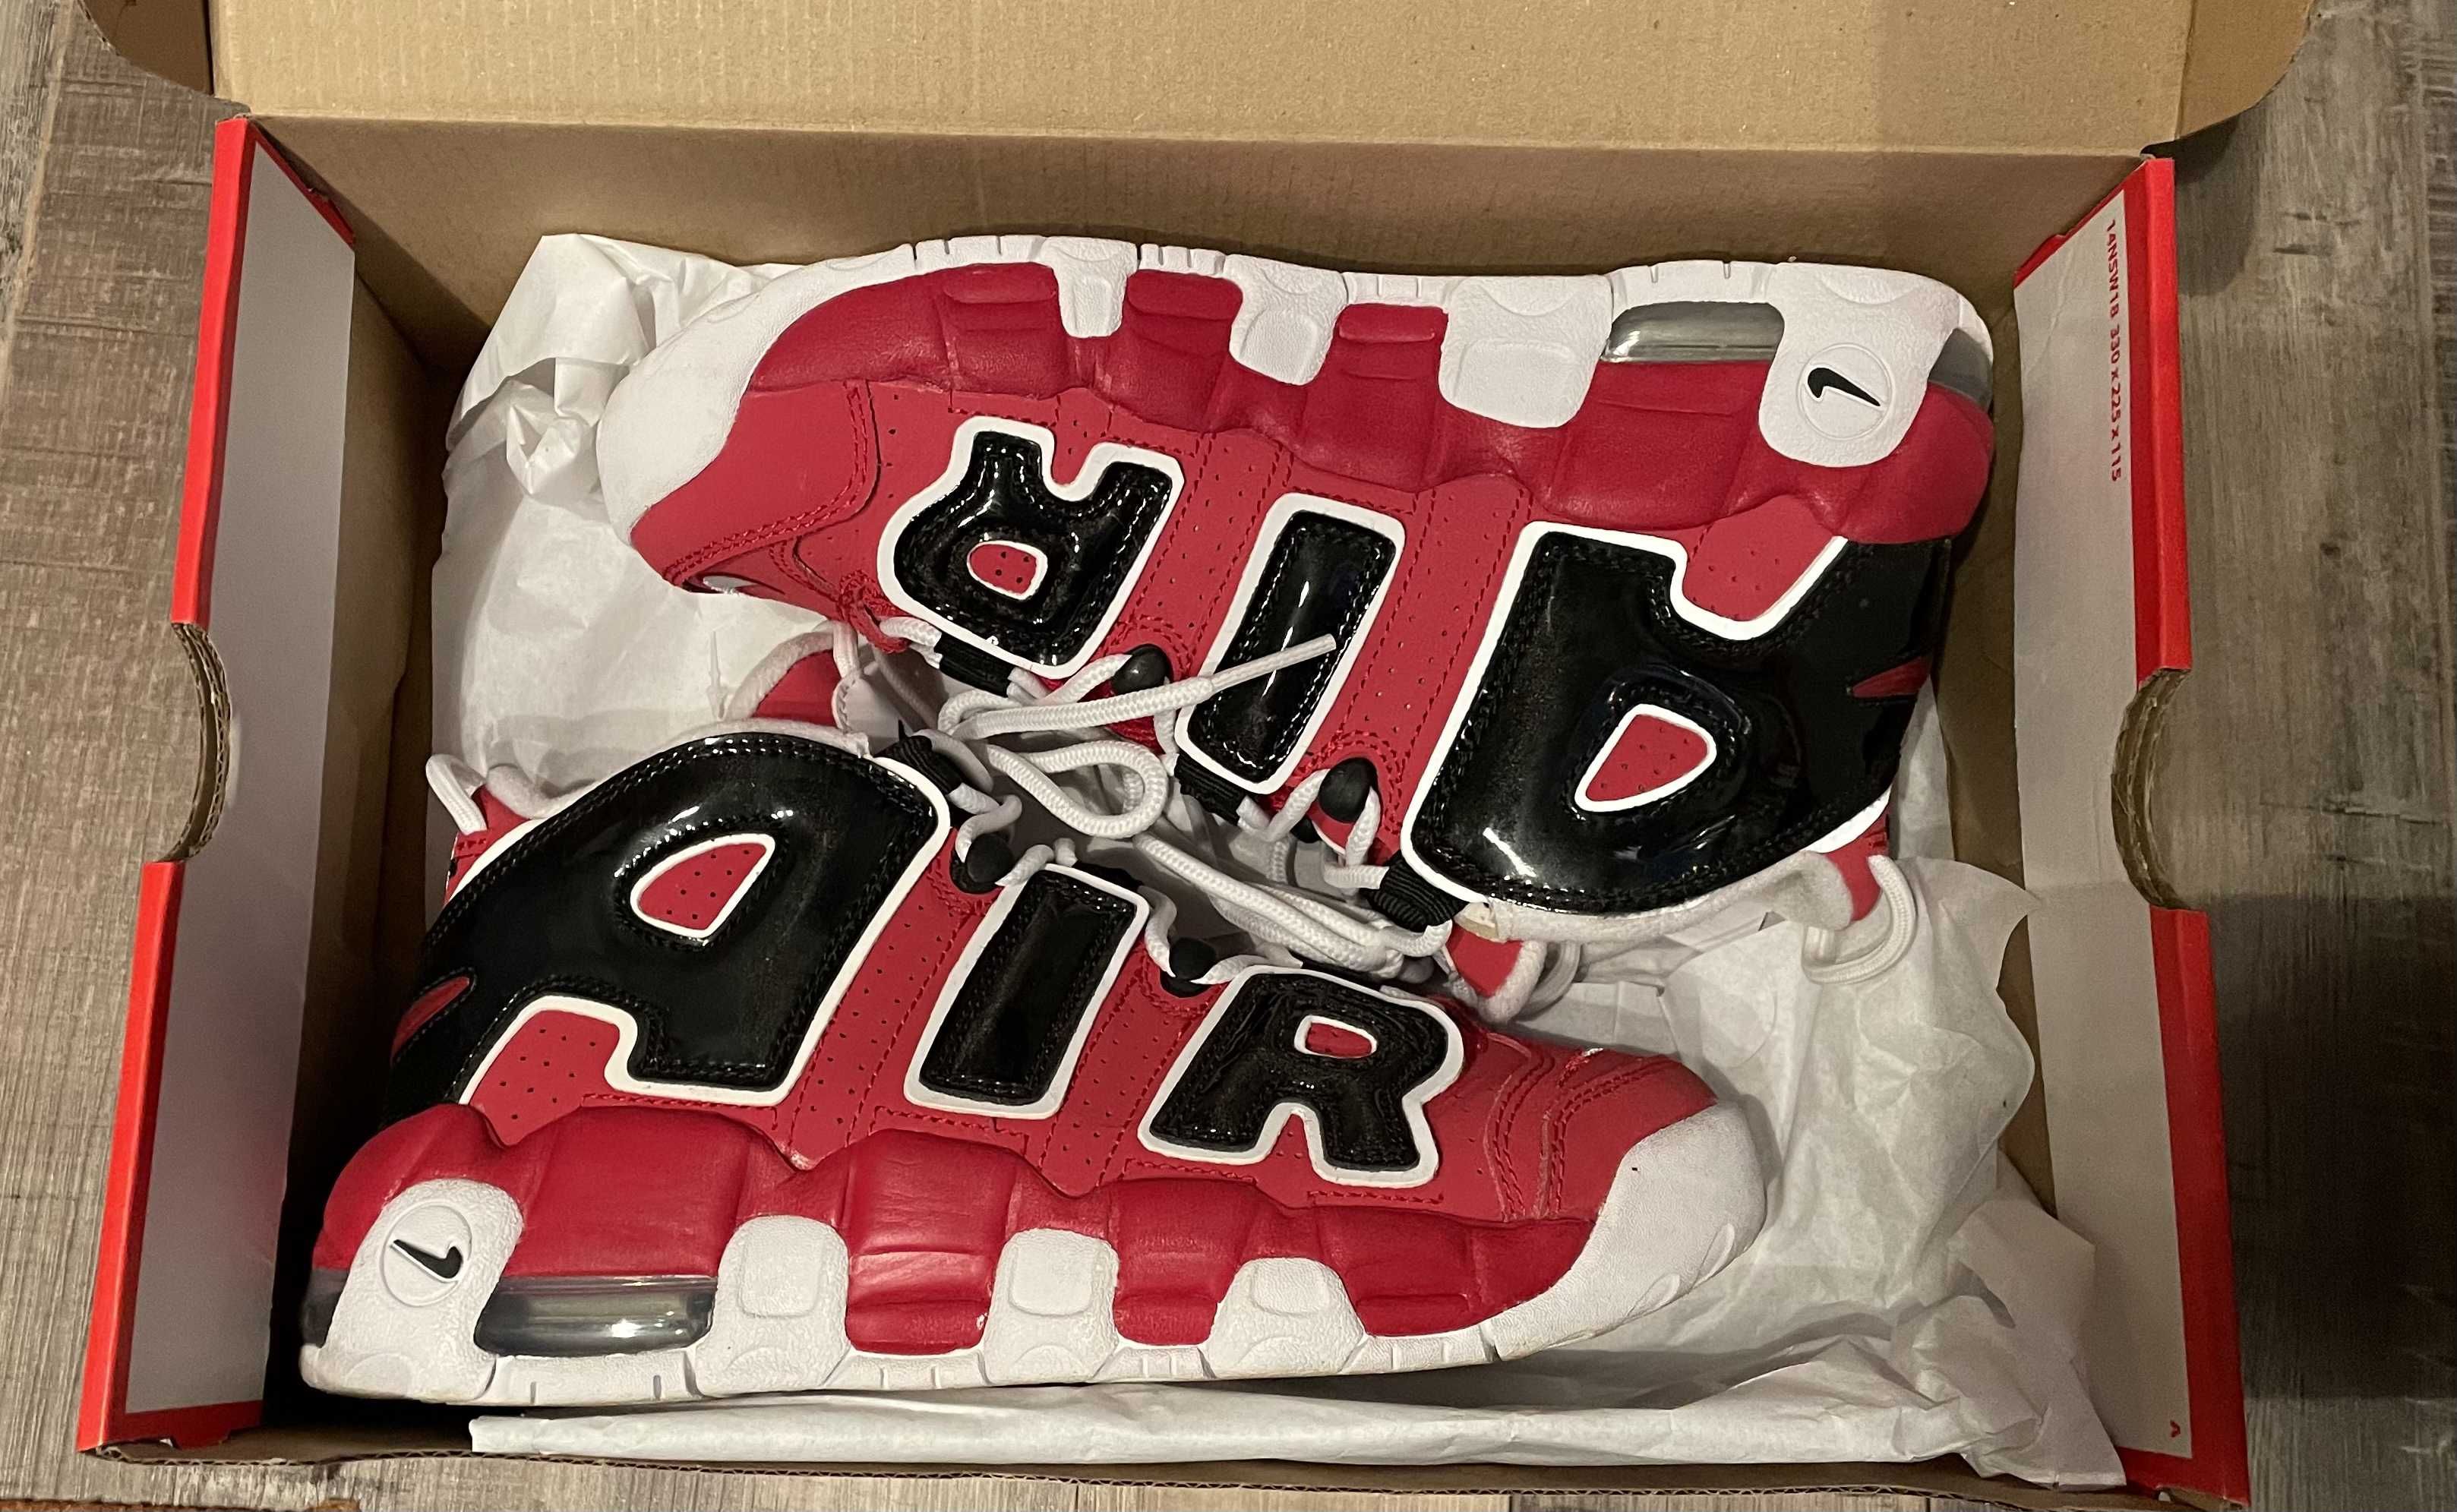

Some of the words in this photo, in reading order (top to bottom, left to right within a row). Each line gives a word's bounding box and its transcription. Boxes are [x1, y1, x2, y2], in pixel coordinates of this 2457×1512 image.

[2109, 324, 2121, 364] 330
[2110, 383, 2121, 422] 225
[2111, 443, 2122, 482] 115
[876, 415, 1952, 918] AIR
[386, 731, 1464, 1188] AIR
